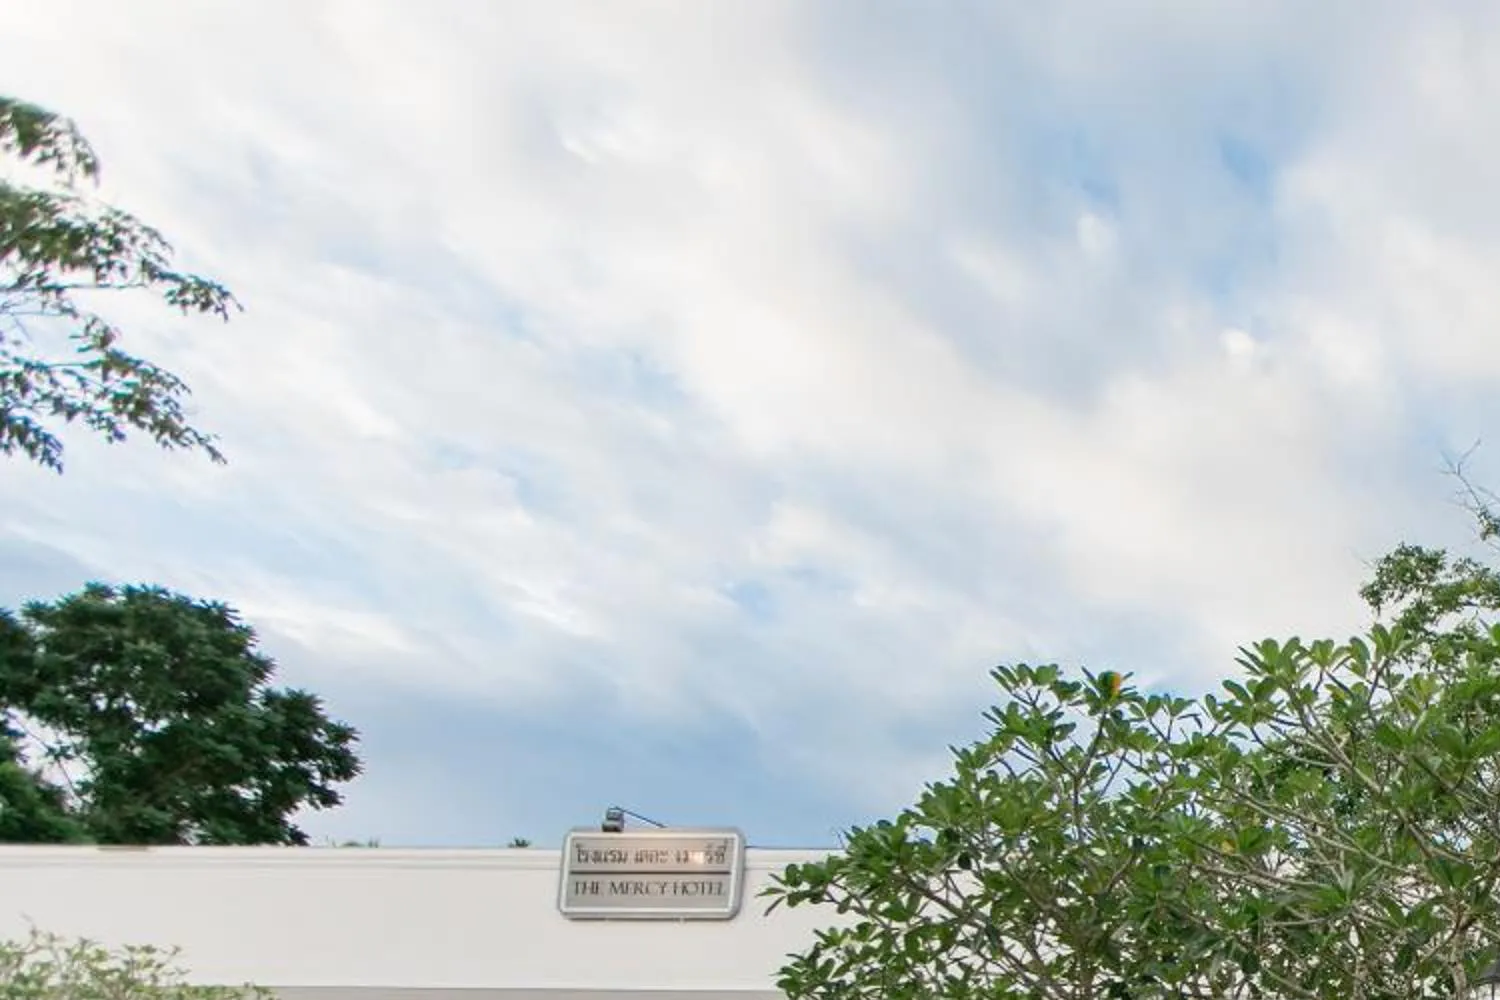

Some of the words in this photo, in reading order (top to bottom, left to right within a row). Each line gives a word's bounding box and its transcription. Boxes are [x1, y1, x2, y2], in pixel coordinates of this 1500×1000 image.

[575, 880, 603, 896] THE
[609, 880, 670, 896] MERCY
[672, 880, 725, 897] HOTEL
